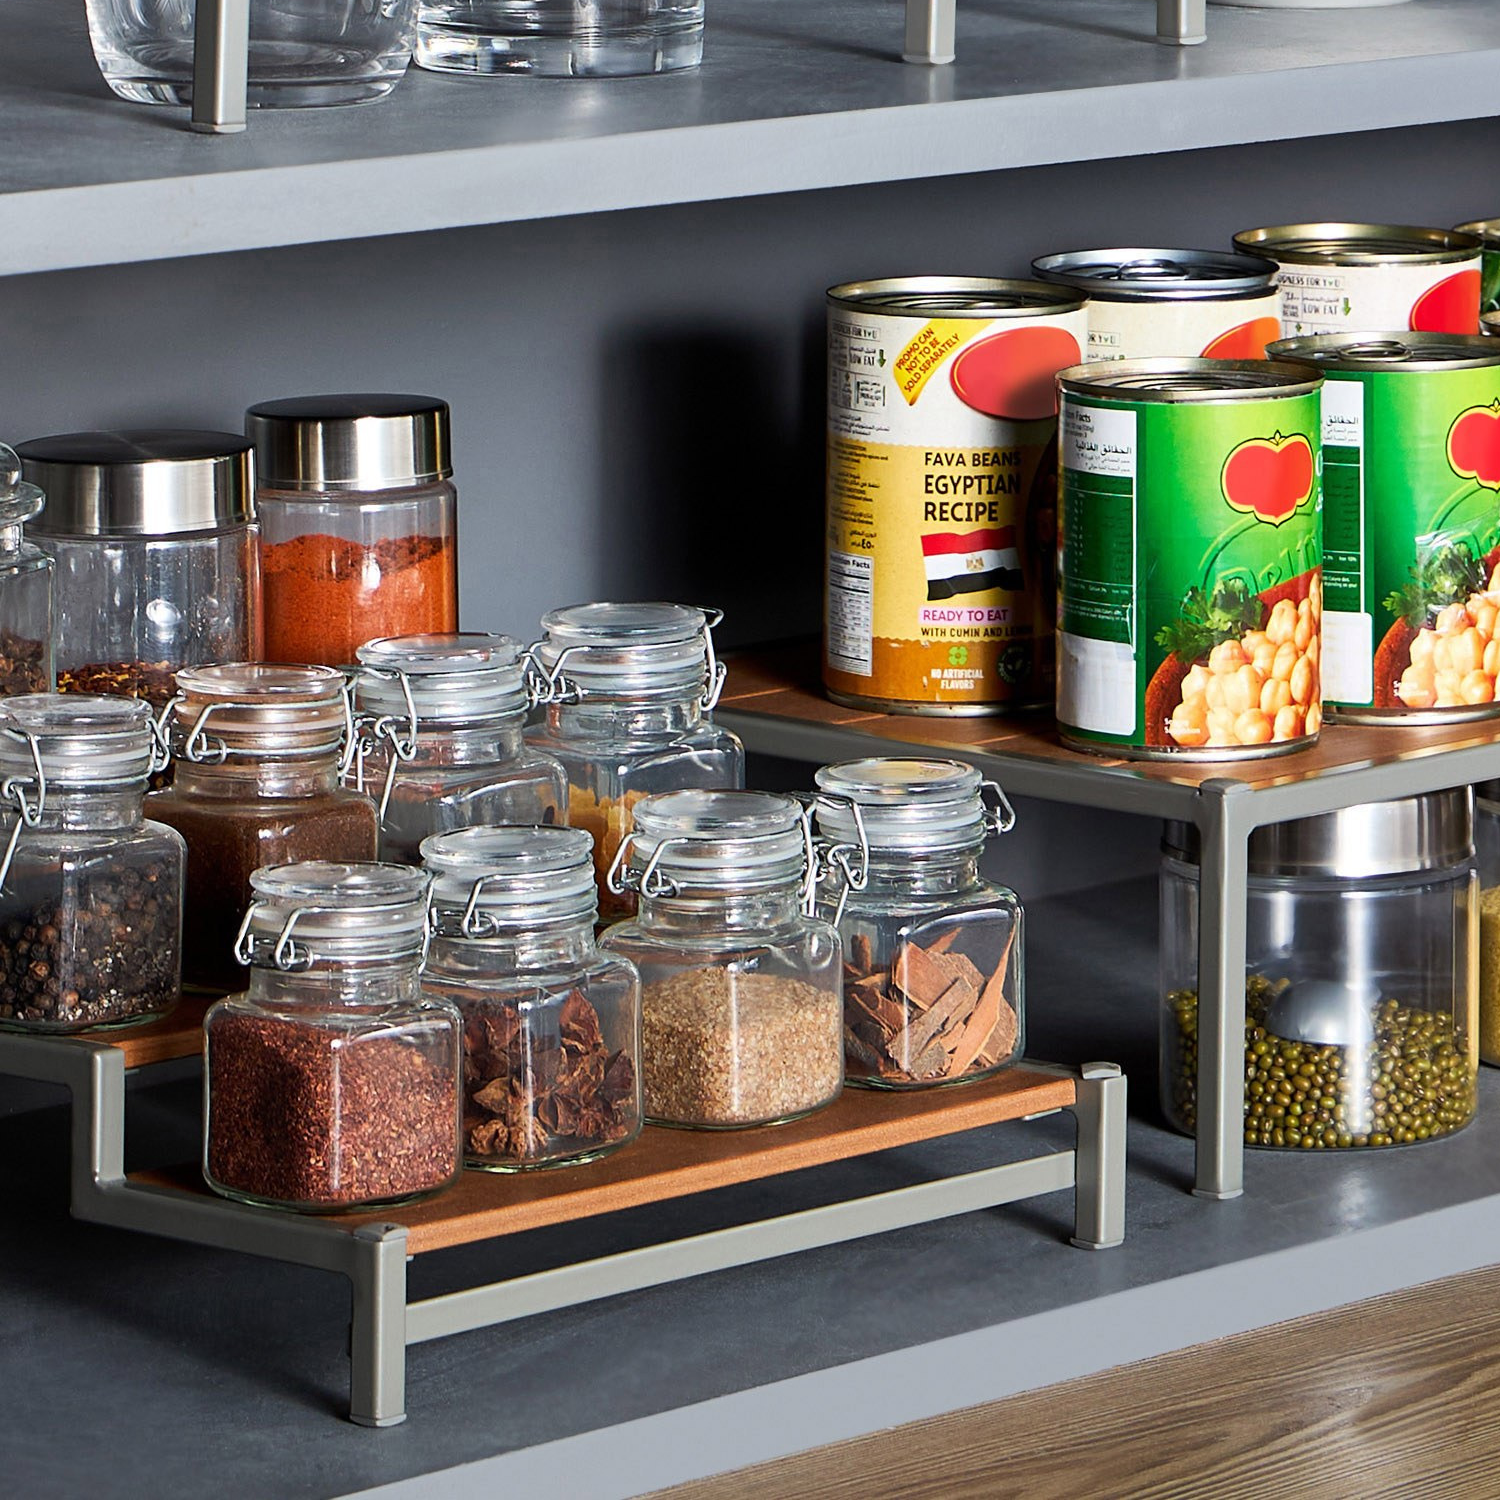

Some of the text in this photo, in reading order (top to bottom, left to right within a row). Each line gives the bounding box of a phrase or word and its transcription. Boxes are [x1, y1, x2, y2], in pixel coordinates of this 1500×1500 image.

[1303, 303, 1319, 314] LOW
[1323, 305, 1337, 315] FAT
[896, 328, 934, 370] PROMO CAN
[905, 337, 941, 374] NOT TO BE
[904, 333, 960, 392] SOLD SEPARATELY
[925, 452, 1021, 467] FAVA BEANS
[924, 474, 1020, 495] EGYPTIAN
[924, 501, 999, 522] RECIPE
[851, 560, 870, 569] Facts
[923, 609, 1009, 621] READY TO EAT
[921, 628, 946, 637] WITH
[950, 628, 980, 637] CUMIN
[983, 628, 1003, 637] AND
[930, 669, 984, 679] NO ARTIFICIAL
[941, 680, 975, 690] FLAVORS
